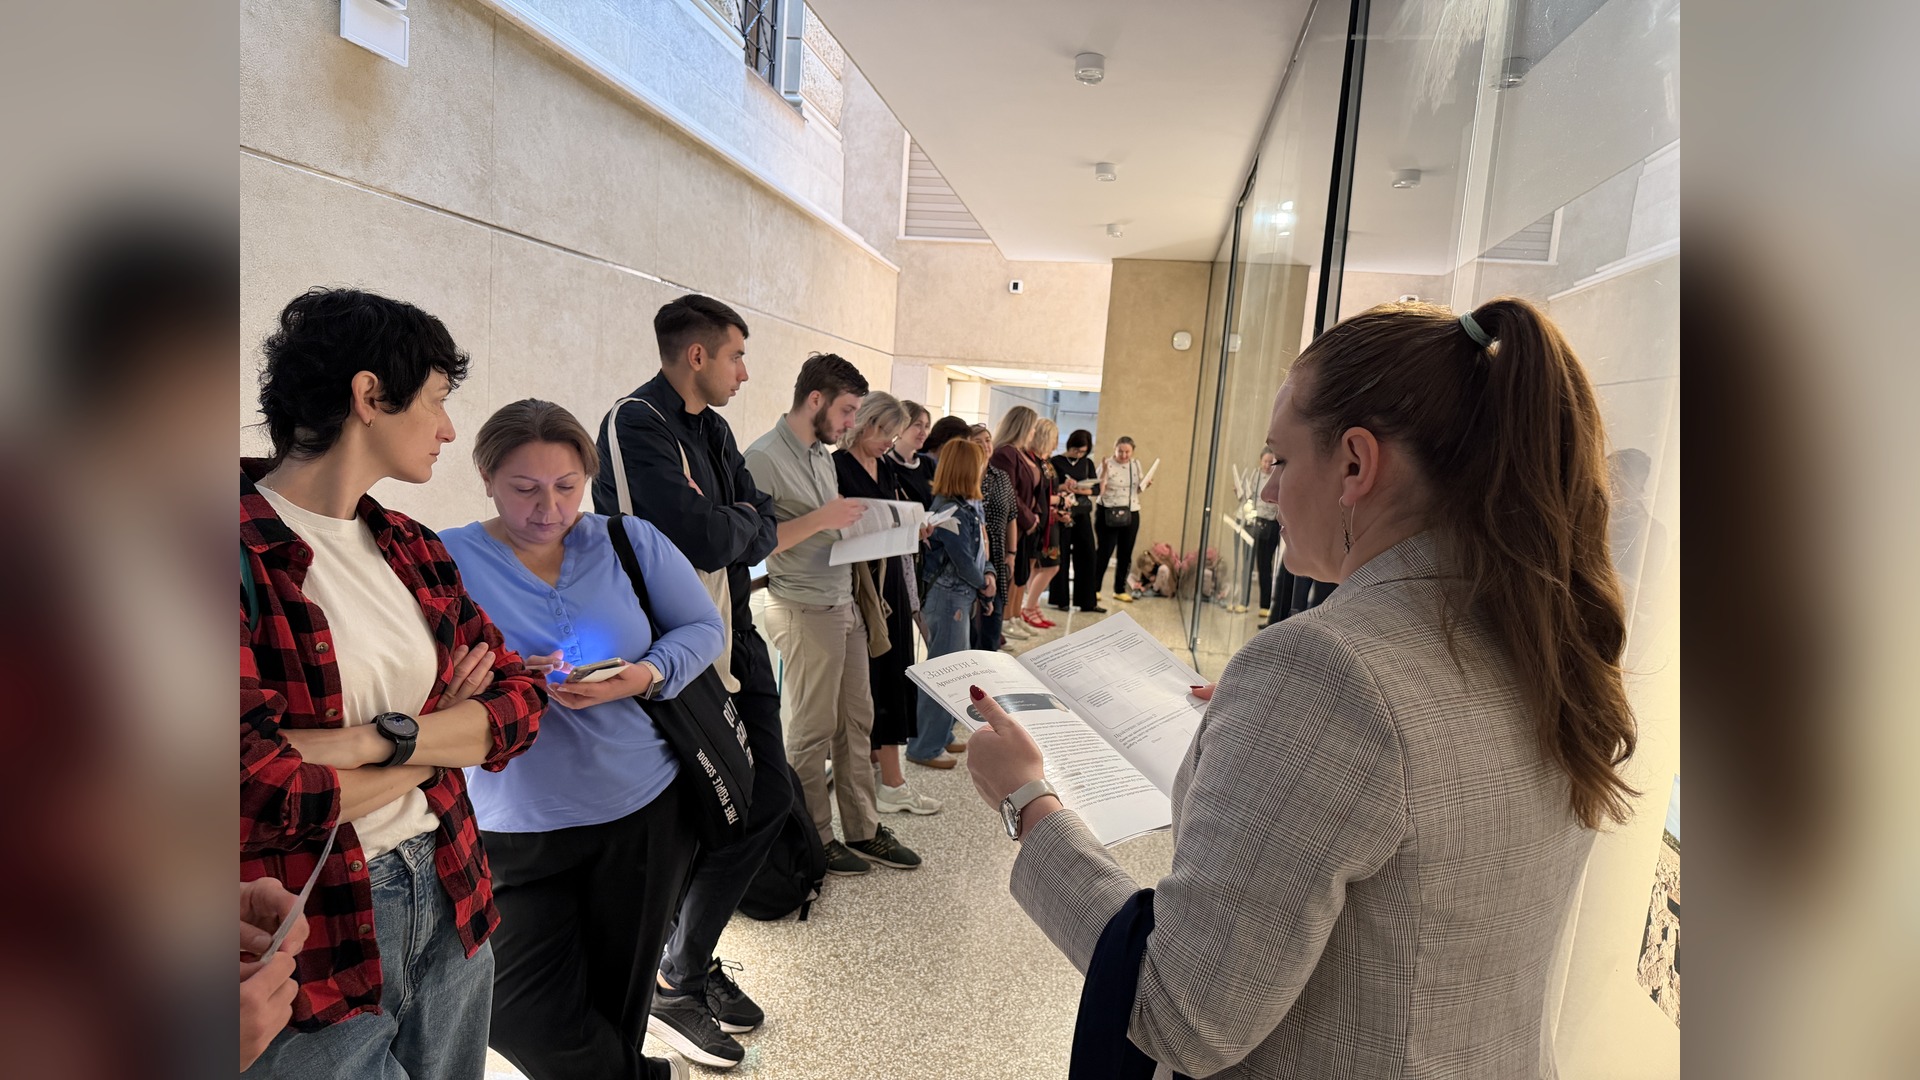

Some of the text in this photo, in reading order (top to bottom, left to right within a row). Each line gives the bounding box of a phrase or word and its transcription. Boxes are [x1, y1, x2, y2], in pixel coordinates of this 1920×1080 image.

[923, 661, 971, 680] Заняття
[696, 748, 739, 825] FREE PEOPLE SCHOOL
